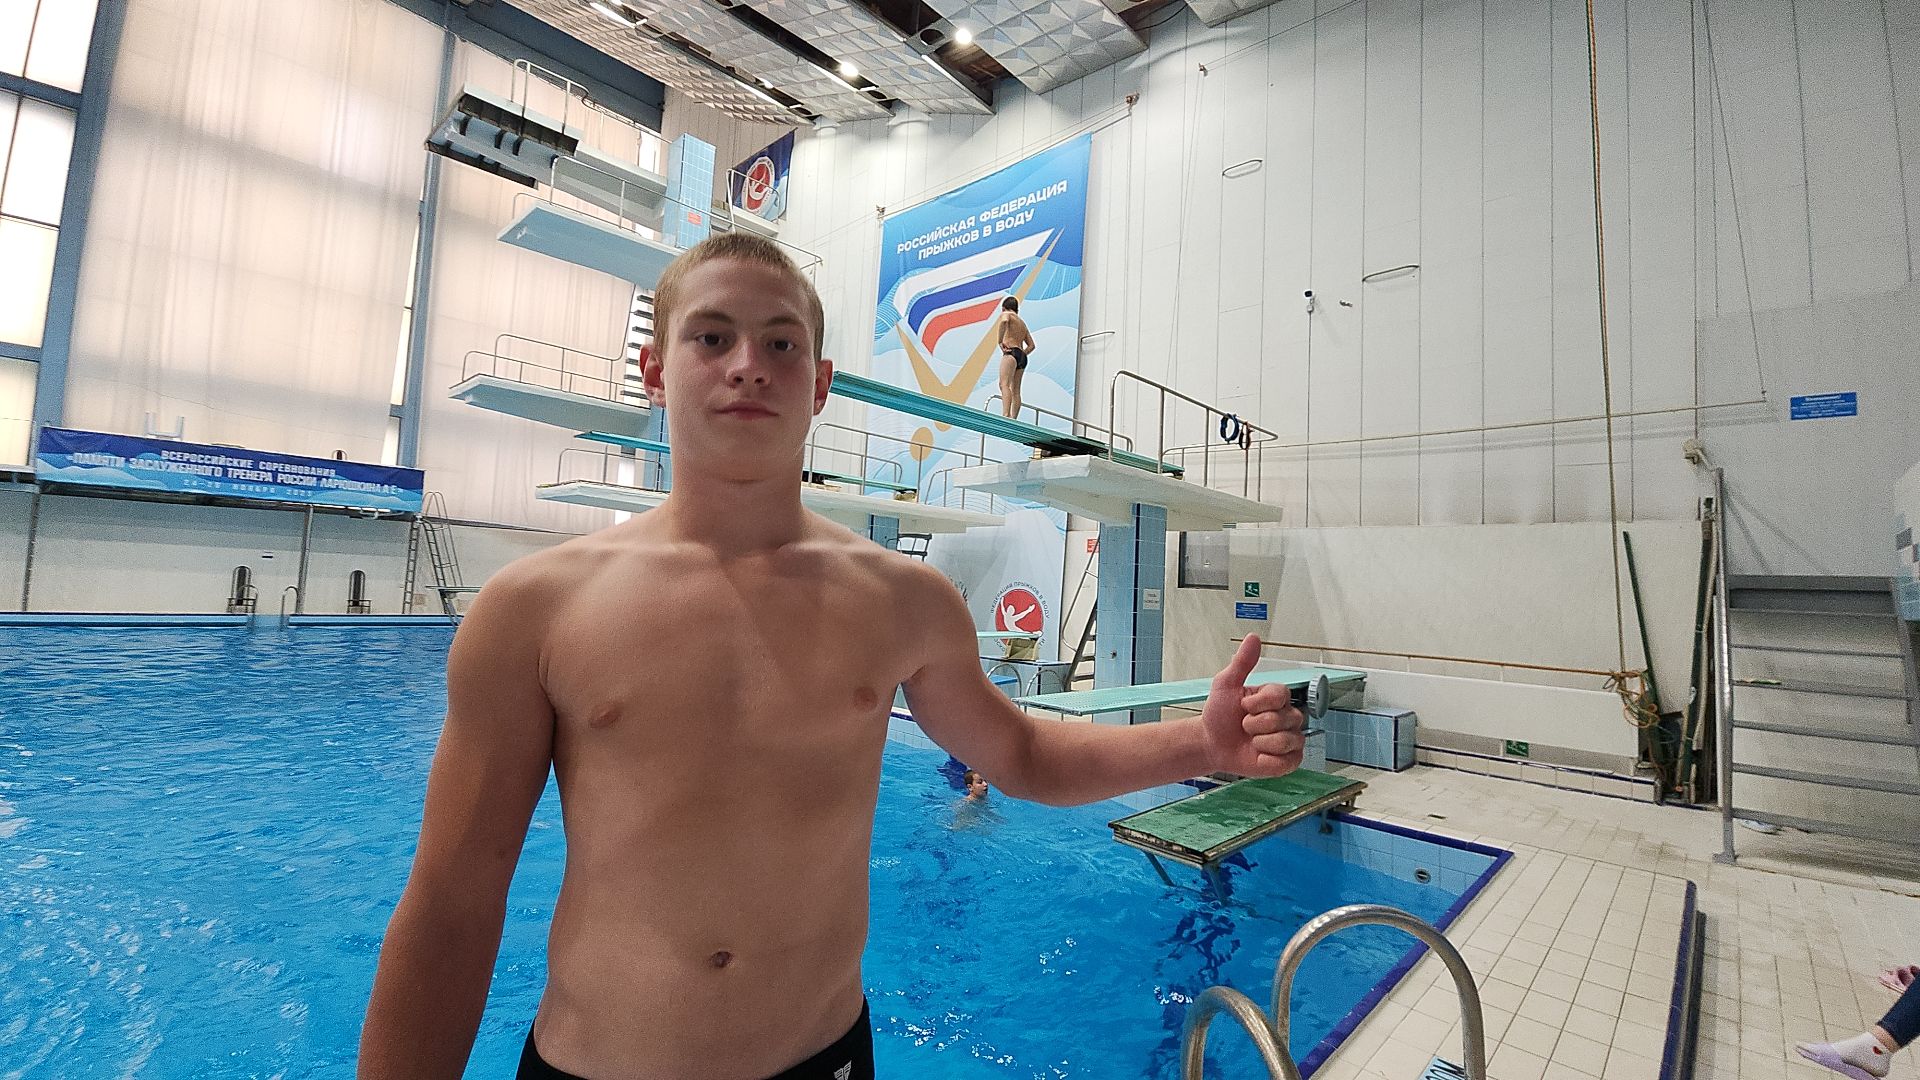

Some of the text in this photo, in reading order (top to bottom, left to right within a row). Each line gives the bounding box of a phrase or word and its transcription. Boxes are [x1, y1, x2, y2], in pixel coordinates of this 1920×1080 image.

[897, 180, 1068, 254] РОССИЙСКАЯ ФЕДЕРАЦИЯ
[918, 208, 1035, 261] ПРЫЖКОВ В ВОДУ
[129, 458, 223, 478] ЗАСЛУЖЕННОГО
[227, 467, 273, 483] ТРЕНЕРА
[277, 474, 317, 487] РОССИИ
[160, 450, 336, 477] ВСЕРОССИЙСКИЕ СОРЕВНОВАНИЯ
[1013, 581, 1040, 596] ПРЫЖКОВ
[1041, 600, 1050, 619] ВОДУ
